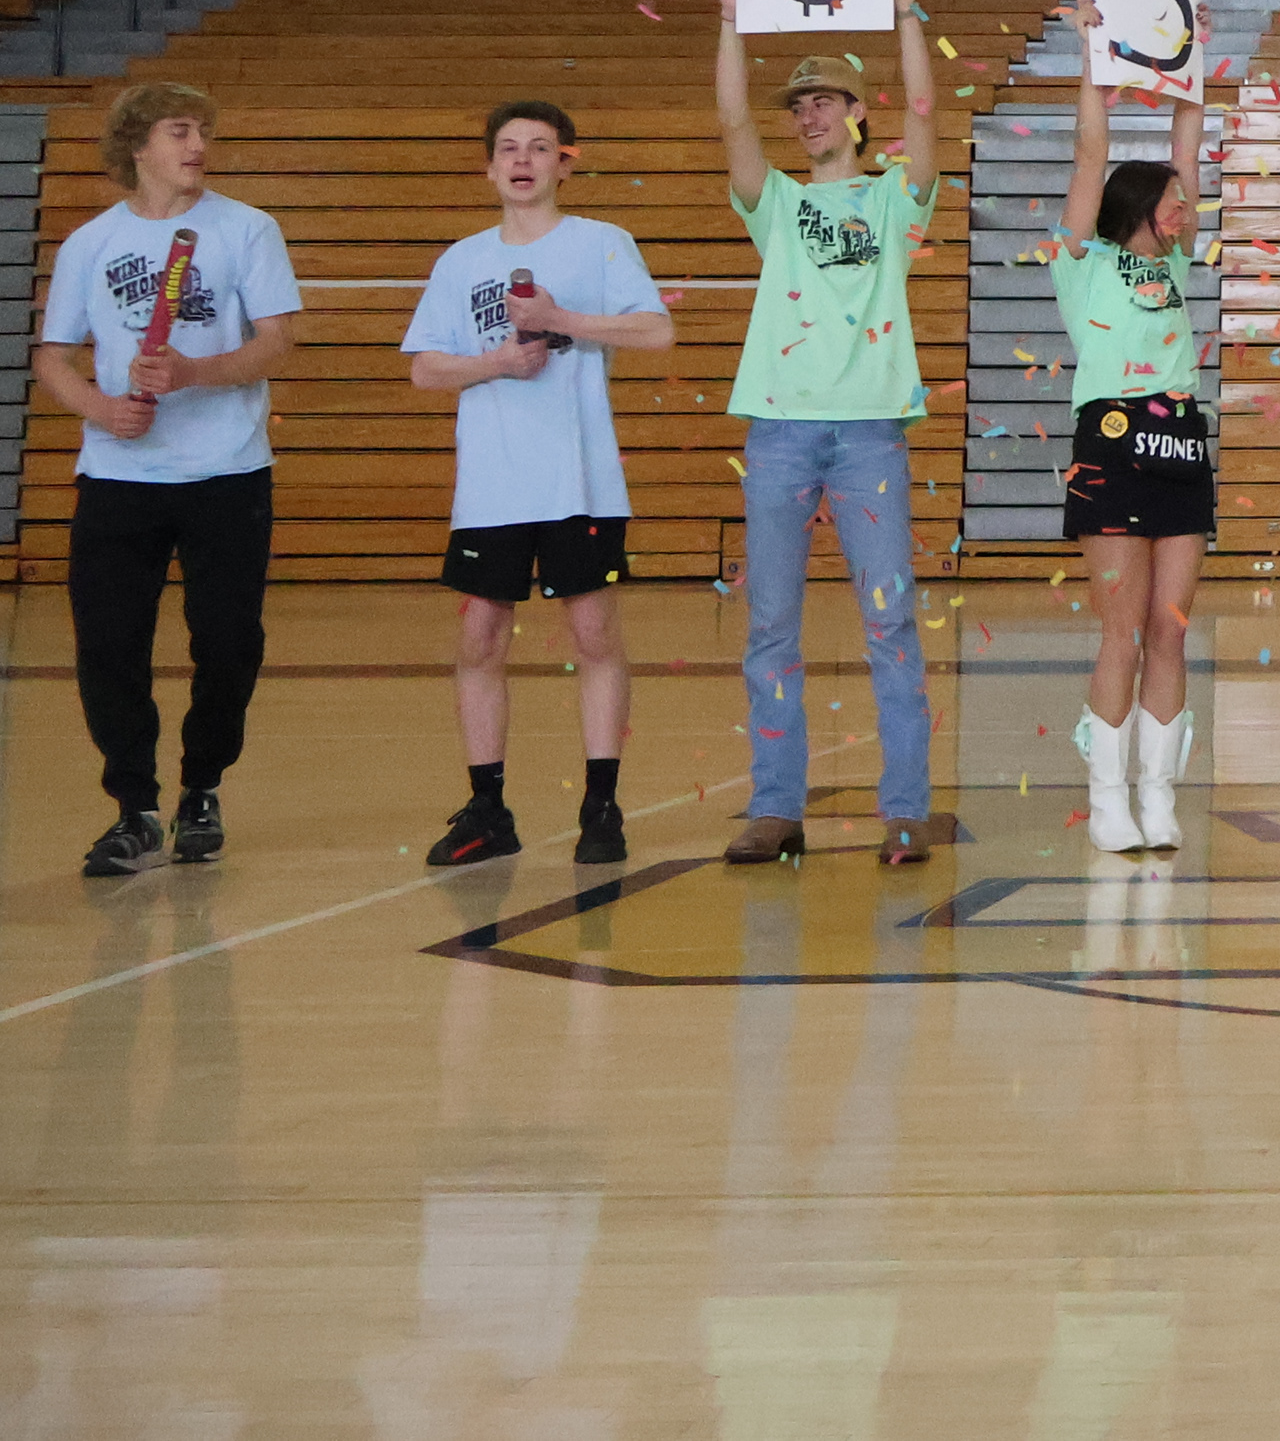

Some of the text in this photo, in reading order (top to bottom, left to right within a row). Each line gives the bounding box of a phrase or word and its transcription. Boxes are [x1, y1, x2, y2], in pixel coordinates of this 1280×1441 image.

[106, 255, 156, 289] MINI-
[475, 303, 511, 335] THO
[1134, 432, 1204, 462] SYDNEY
